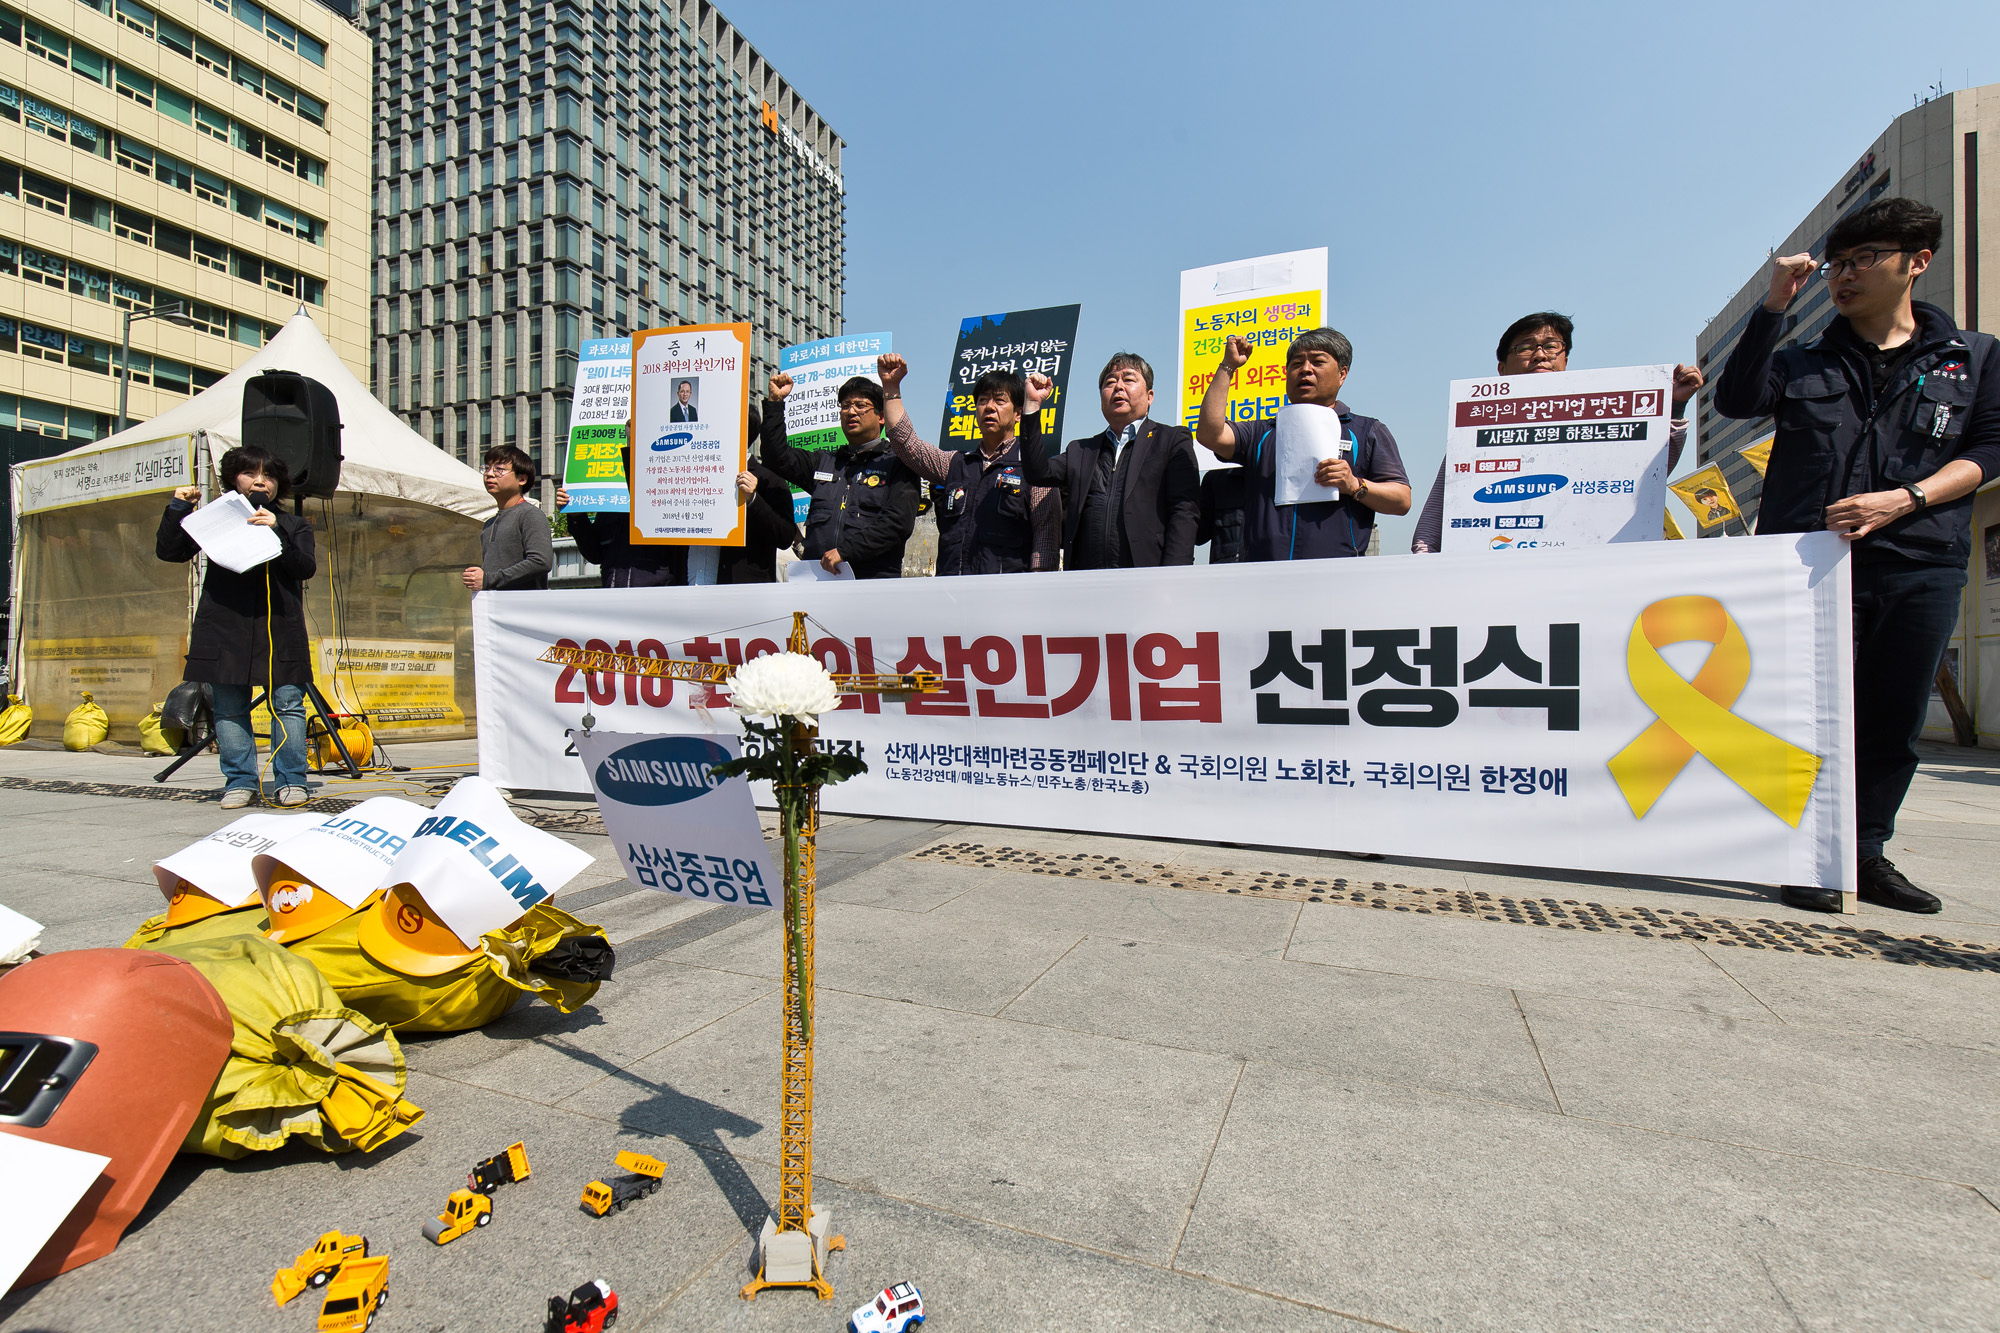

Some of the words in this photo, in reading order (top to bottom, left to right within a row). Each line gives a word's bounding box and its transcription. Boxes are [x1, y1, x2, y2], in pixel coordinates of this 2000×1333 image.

[1194, 308, 1257, 331] 노동자의
[1264, 302, 1311, 322] 생명과
[588, 343, 630, 357] 과로사회
[668, 339, 681, 357] 증
[694, 336, 706, 355] 서
[789, 344, 830, 364] 과로사회
[834, 338, 882, 355] 대한민국
[960, 345, 998, 361] 죽거나
[1000, 341, 1039, 357] 다치지
[1040, 339, 1068, 353] 않는
[642, 363, 661, 375] 2018
[662, 358, 692, 374] 최악의
[693, 356, 735, 372] 살인기업
[808, 363, 858, 382] 78~89시간
[583, 385, 601, 394] 30대
[1470, 382, 1511, 398] 2018
[581, 397, 594, 408] 4명
[595, 397, 611, 407] 몫의
[612, 397, 629, 407] 일을
[788, 391, 806, 403] 20대
[578, 410, 609, 421] (2018년
[610, 409, 628, 420] 1월)
[788, 402, 819, 417] 심근경색
[1469, 402, 1517, 422] 최악의
[1520, 398, 1586, 420] 살인기업
[1590, 395, 1627, 416] 명단
[787, 416, 818, 430] (2016년
[576, 429, 590, 440] 1년
[591, 428, 616, 439] 300명
[822, 431, 838, 443] 1달
[1534, 427, 1560, 442] 전원
[655, 437, 689, 447] SAMSUNG
[690, 440, 720, 450] 삼성중공업
[672, 454, 690, 462] 2017년
[134, 454, 184, 483] 진실마중대
[669, 465, 692, 473] 노동자를
[693, 465, 717, 473] 사망하게
[1454, 463, 1471, 473] 1위
[1478, 462, 1497, 472] 6명
[1497, 460, 1519, 471] 사망
[76, 477, 101, 491] 서명으로
[103, 472, 132, 486] 지켜주세요!
[674, 477, 711, 485] 살인기업이다.
[1571, 480, 1634, 494] 삼성중공업
[1484, 483, 1557, 495] SAMSUNG
[673, 499, 690, 507] 증서를
[662, 512, 680, 520] 2018년
[681, 512, 690, 520] 4월
[691, 512, 704, 520] 25일
[1450, 517, 1491, 528] 공동2위
[1498, 518, 1517, 528] 5명
[1517, 517, 1541, 528] 사망
[385, 649, 416, 659] 진상규명,
[365, 662, 389, 671] 서명을
[391, 662, 406, 671] 받고
[407, 662, 437, 672] 있습니다.
[896, 631, 1223, 723] 살인기업
[1249, 622, 1581, 731] 선정식
[604, 757, 719, 790] SAMSUNG
[884, 742, 1149, 776] 산재사망대책마련공동캠페인단
[1154, 754, 1172, 775] &
[1178, 754, 1268, 782] 국회의원
[1275, 758, 1356, 788] 노회찬,
[1363, 761, 1471, 792] 국회의원
[1479, 765, 1569, 797] 한정애
[884, 767, 1151, 795] (노동건강연대/매일노동뉴스/민주노총/한국노총)
[411, 815, 549, 912] DAELIM
[627, 842, 773, 907] 삼성중공업
[633, 1160, 659, 1172] HEAVY
